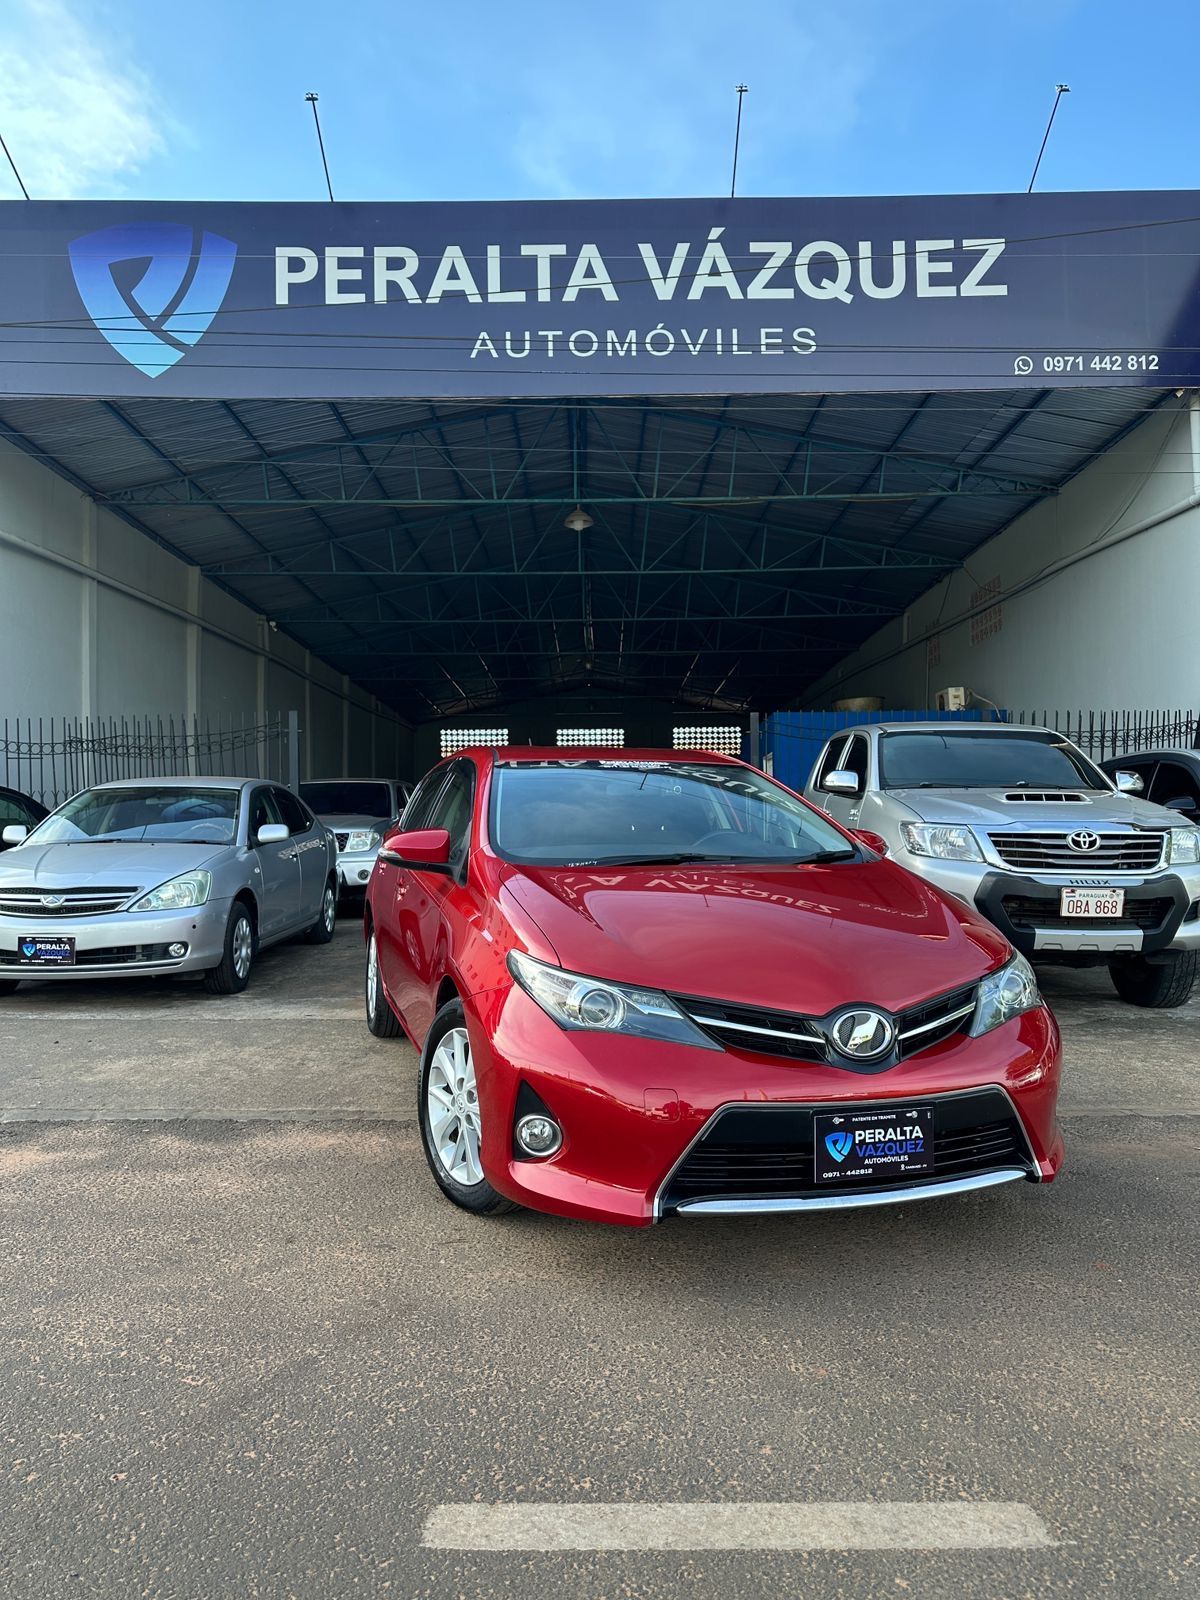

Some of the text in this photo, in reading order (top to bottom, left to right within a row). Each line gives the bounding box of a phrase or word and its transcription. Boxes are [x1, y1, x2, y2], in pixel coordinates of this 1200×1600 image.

[275, 227, 1008, 305] PERALTA VÁZQUEZ
[470, 322, 817, 359] AUTOMÓVILES
[1043, 354, 1159, 372] 0971 442 812
[1067, 899, 1118, 914] OBA 868
[855, 1126, 923, 1143] PERALTA
[856, 1140, 924, 1157] VAZQUEZ
[864, 1155, 909, 1165] AUTOMÓVILES
